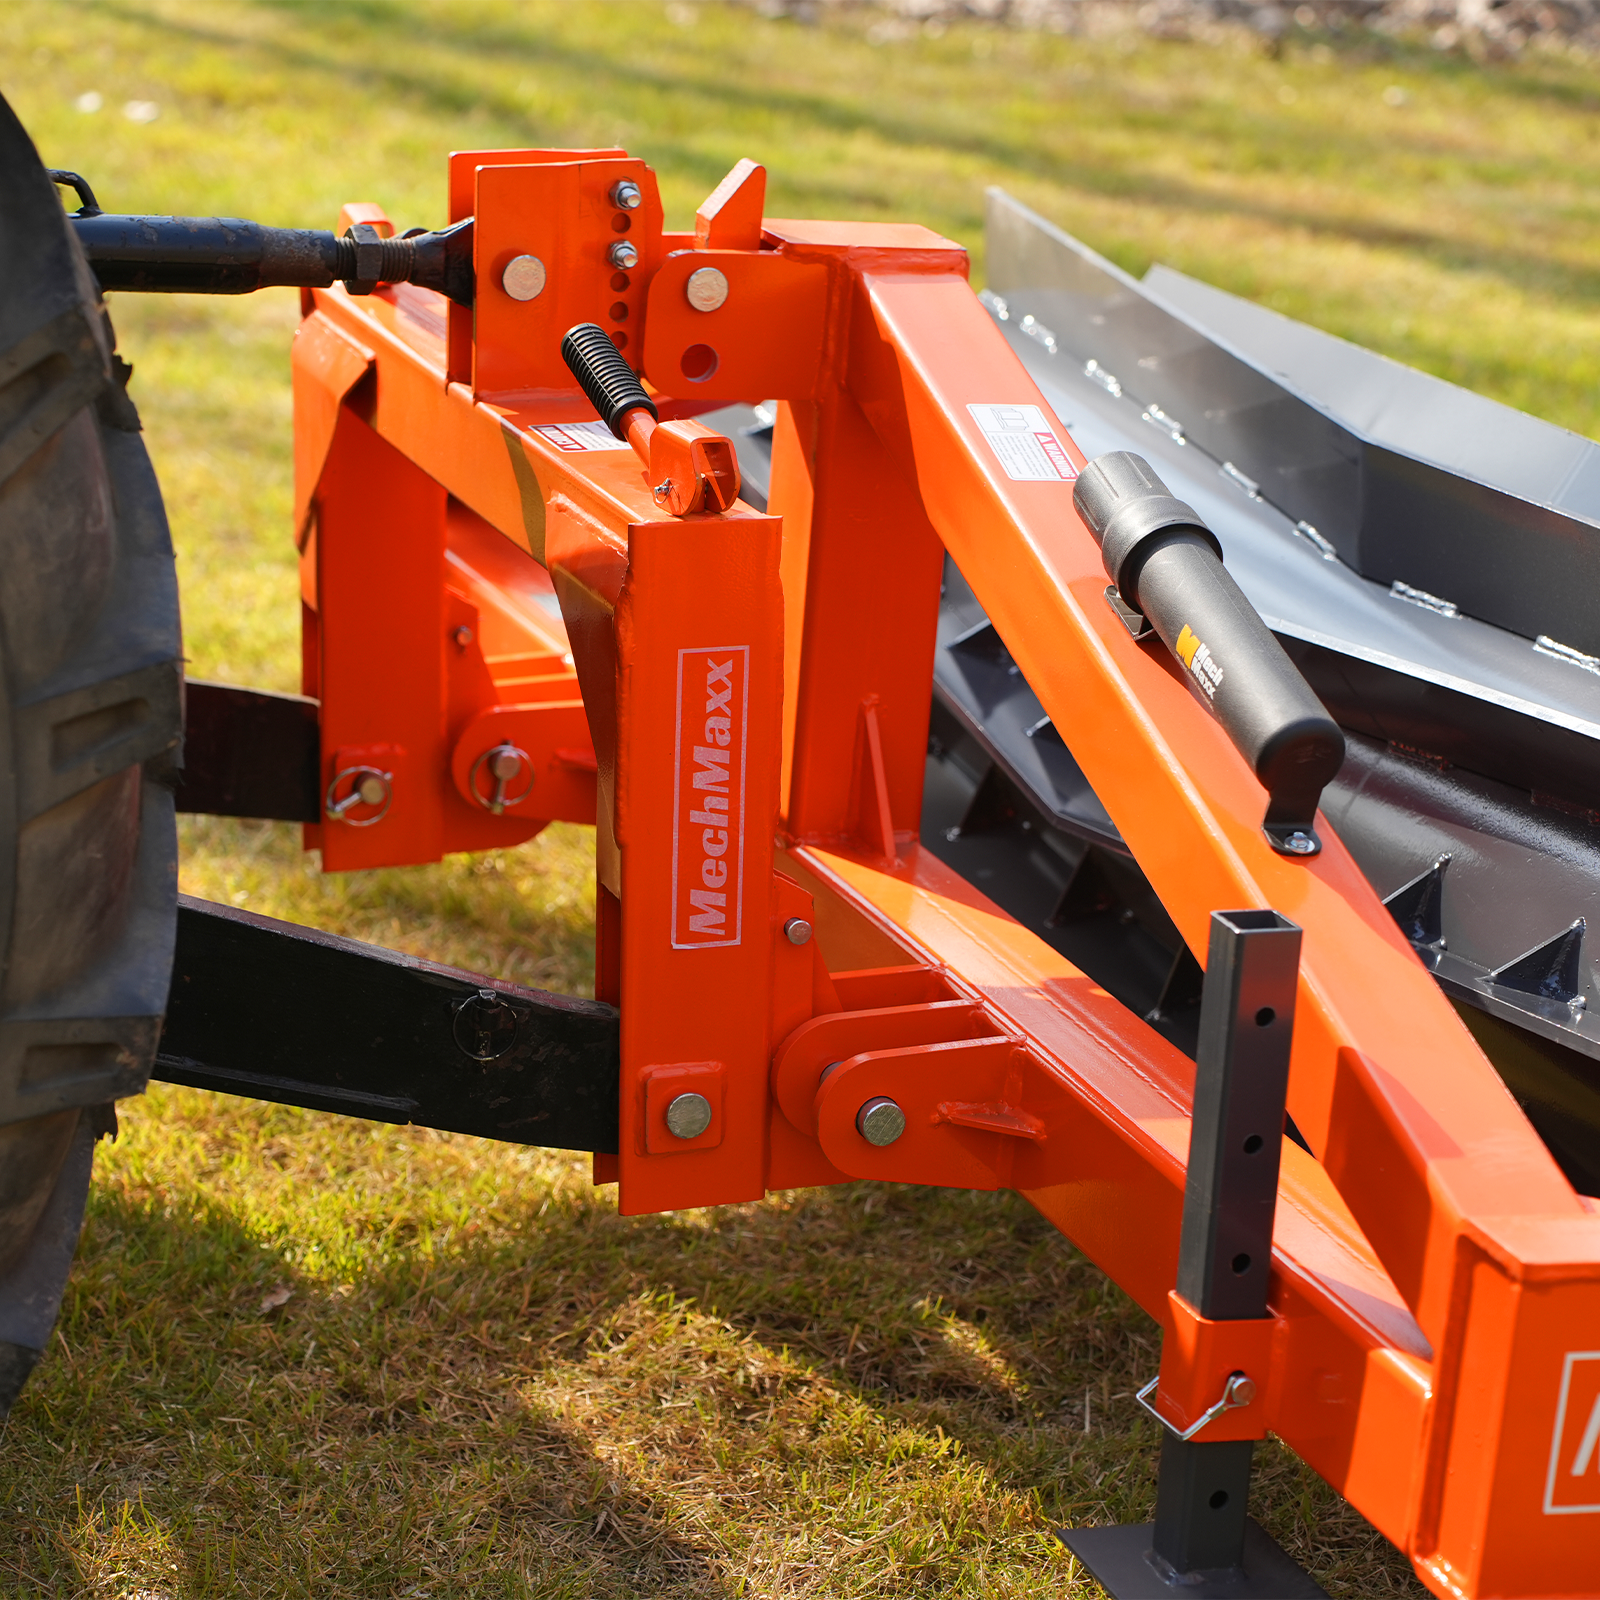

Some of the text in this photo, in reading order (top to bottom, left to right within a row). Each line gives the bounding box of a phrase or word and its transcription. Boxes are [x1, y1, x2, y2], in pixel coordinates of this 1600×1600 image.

[1043, 443, 1076, 478] WARNING
[1191, 656, 1216, 701] Maxx
[1195, 643, 1223, 687] Mech
[689, 658, 733, 935] MechMaxx
